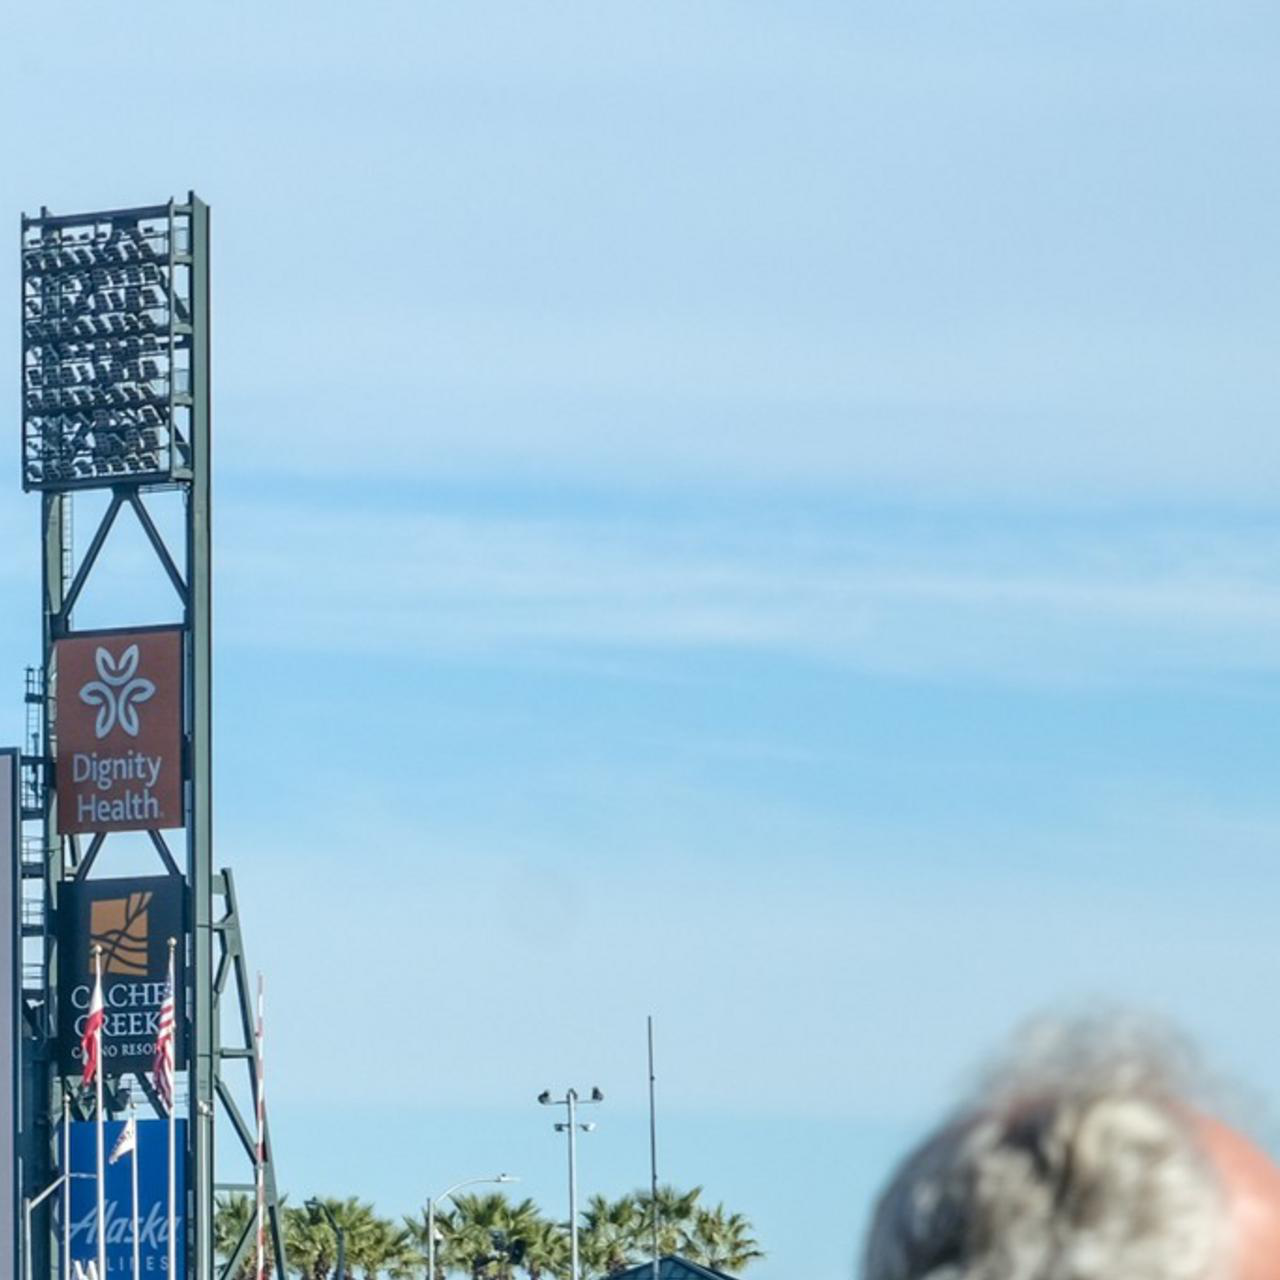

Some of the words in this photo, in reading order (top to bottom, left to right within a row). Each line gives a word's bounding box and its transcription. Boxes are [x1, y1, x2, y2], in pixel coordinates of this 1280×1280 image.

[73, 749, 162, 790] Dignity
[78, 788, 159, 822] Health
[71, 983, 167, 1009] CCHE
[62, 1200, 183, 1249] Alaska
